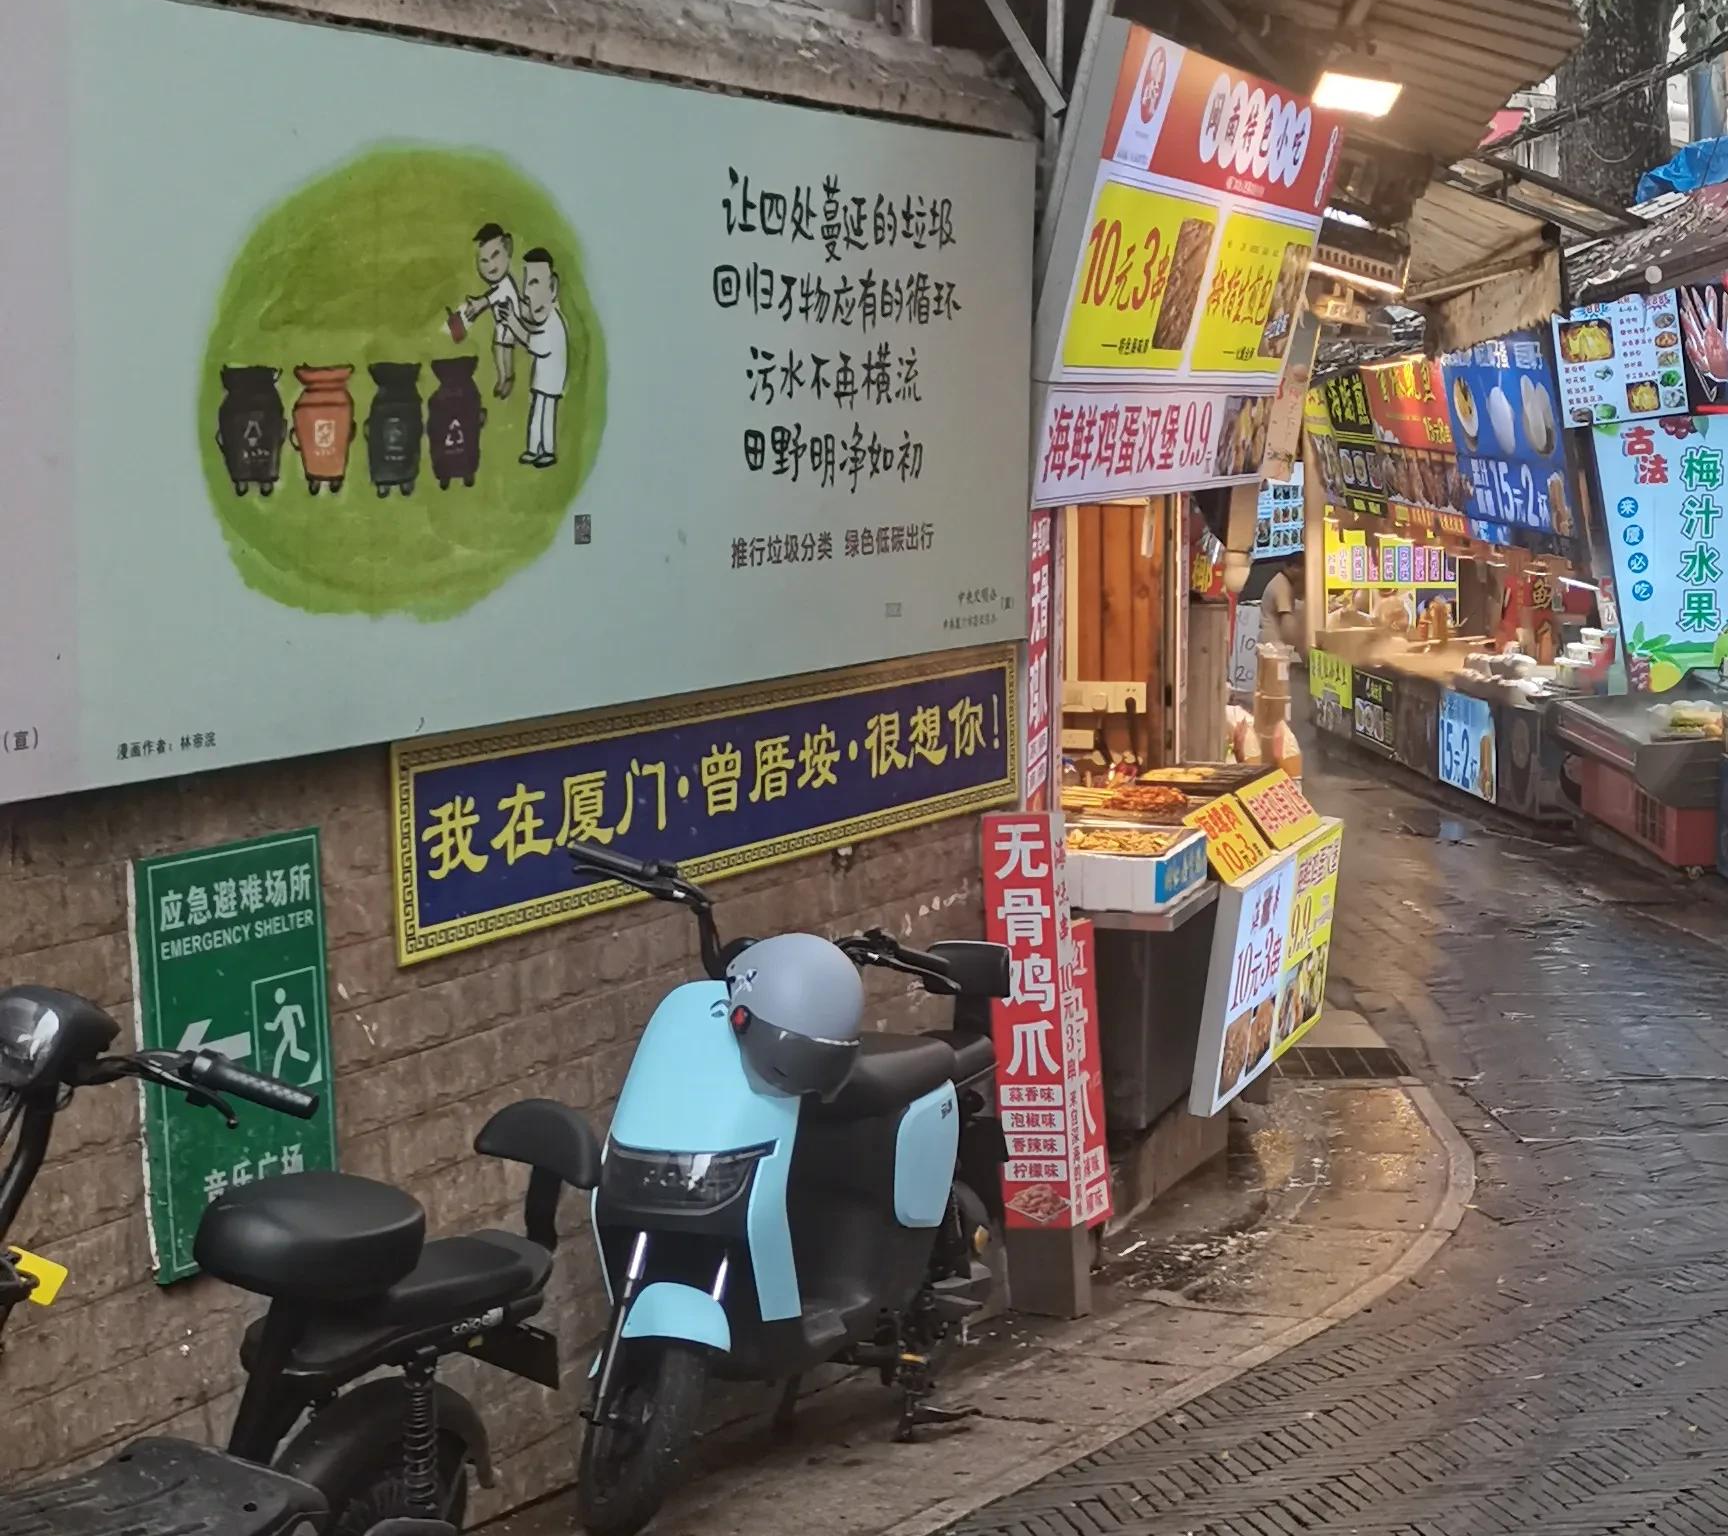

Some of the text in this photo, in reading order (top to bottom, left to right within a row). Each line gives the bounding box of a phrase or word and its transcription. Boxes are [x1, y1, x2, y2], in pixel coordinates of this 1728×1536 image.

[722, 166, 957, 262] 让四处蔓延的垃圾
[745, 341, 922, 409] 污水不再横流
[744, 422, 924, 494] 田野明净如初
[1042, 402, 1181, 483] 海鲜鸡蛋汉堡
[1621, 425, 1669, 486] 古法
[731, 523, 935, 568] 推行垃圾分类 绿色低碳出行
[1678, 446, 1726, 632] 梅汁水果
[160, 863, 311, 932] 应急避难场所
[160, 909, 314, 960] EMERGENCY SHELTER
[995, 824, 1060, 1077] 无骨鸡爪
